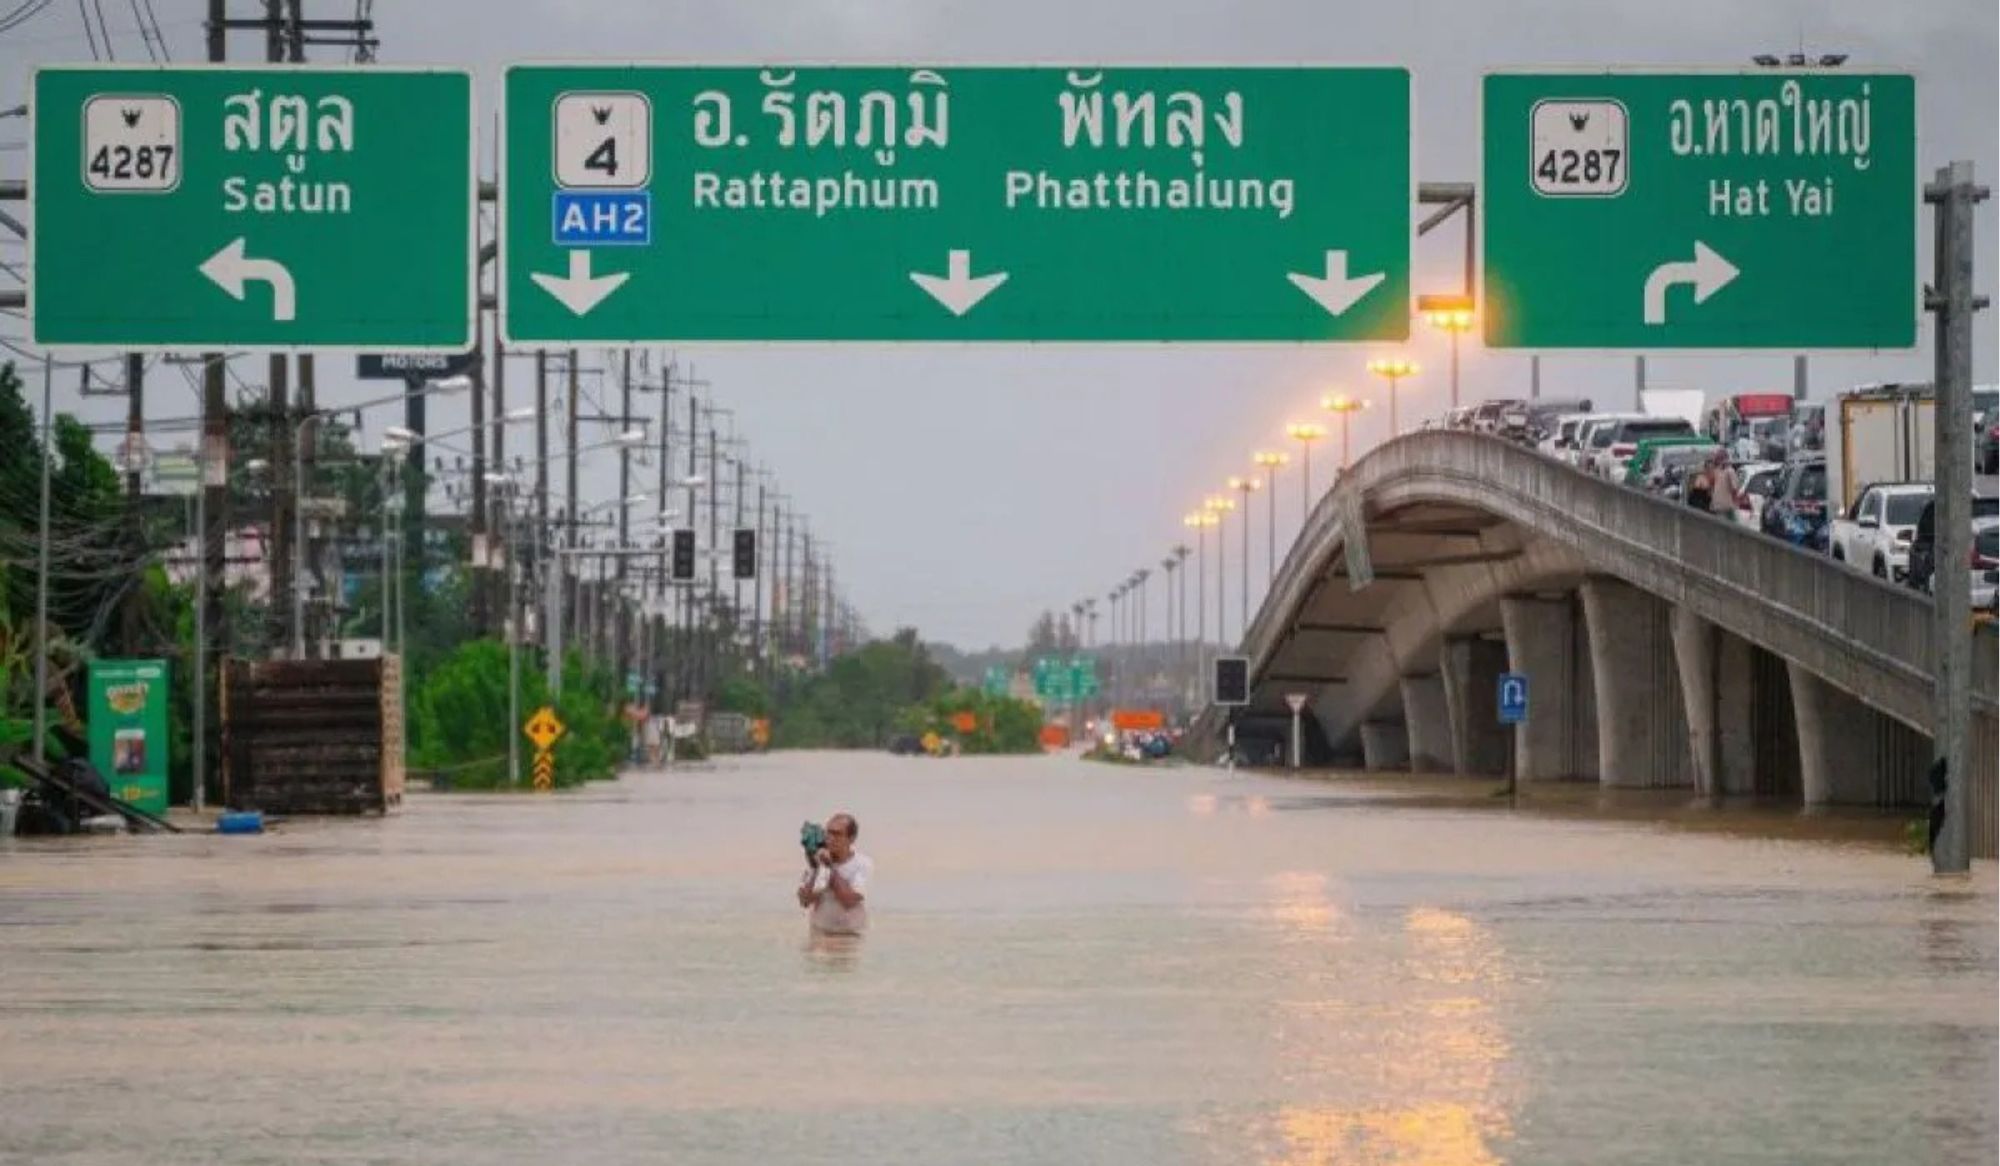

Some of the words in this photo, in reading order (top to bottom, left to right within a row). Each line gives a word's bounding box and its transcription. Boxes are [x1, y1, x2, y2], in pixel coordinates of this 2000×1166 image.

[224, 89, 353, 172] สตูล
[1058, 70, 1244, 168] พัทลุง
[1670, 79, 1871, 169] อ.หาดใหญ่
[89, 145, 173, 180] 4287
[584, 137, 619, 177] 4
[1538, 150, 1621, 184] 4287
[224, 177, 351, 213] Satun
[694, 172, 939, 217] Rattaphum
[1005, 170, 1295, 219] Phatthalung
[1708, 179, 1770, 216] Hat
[1786, 178, 1834, 216] Yai
[561, 203, 644, 233] AH2
